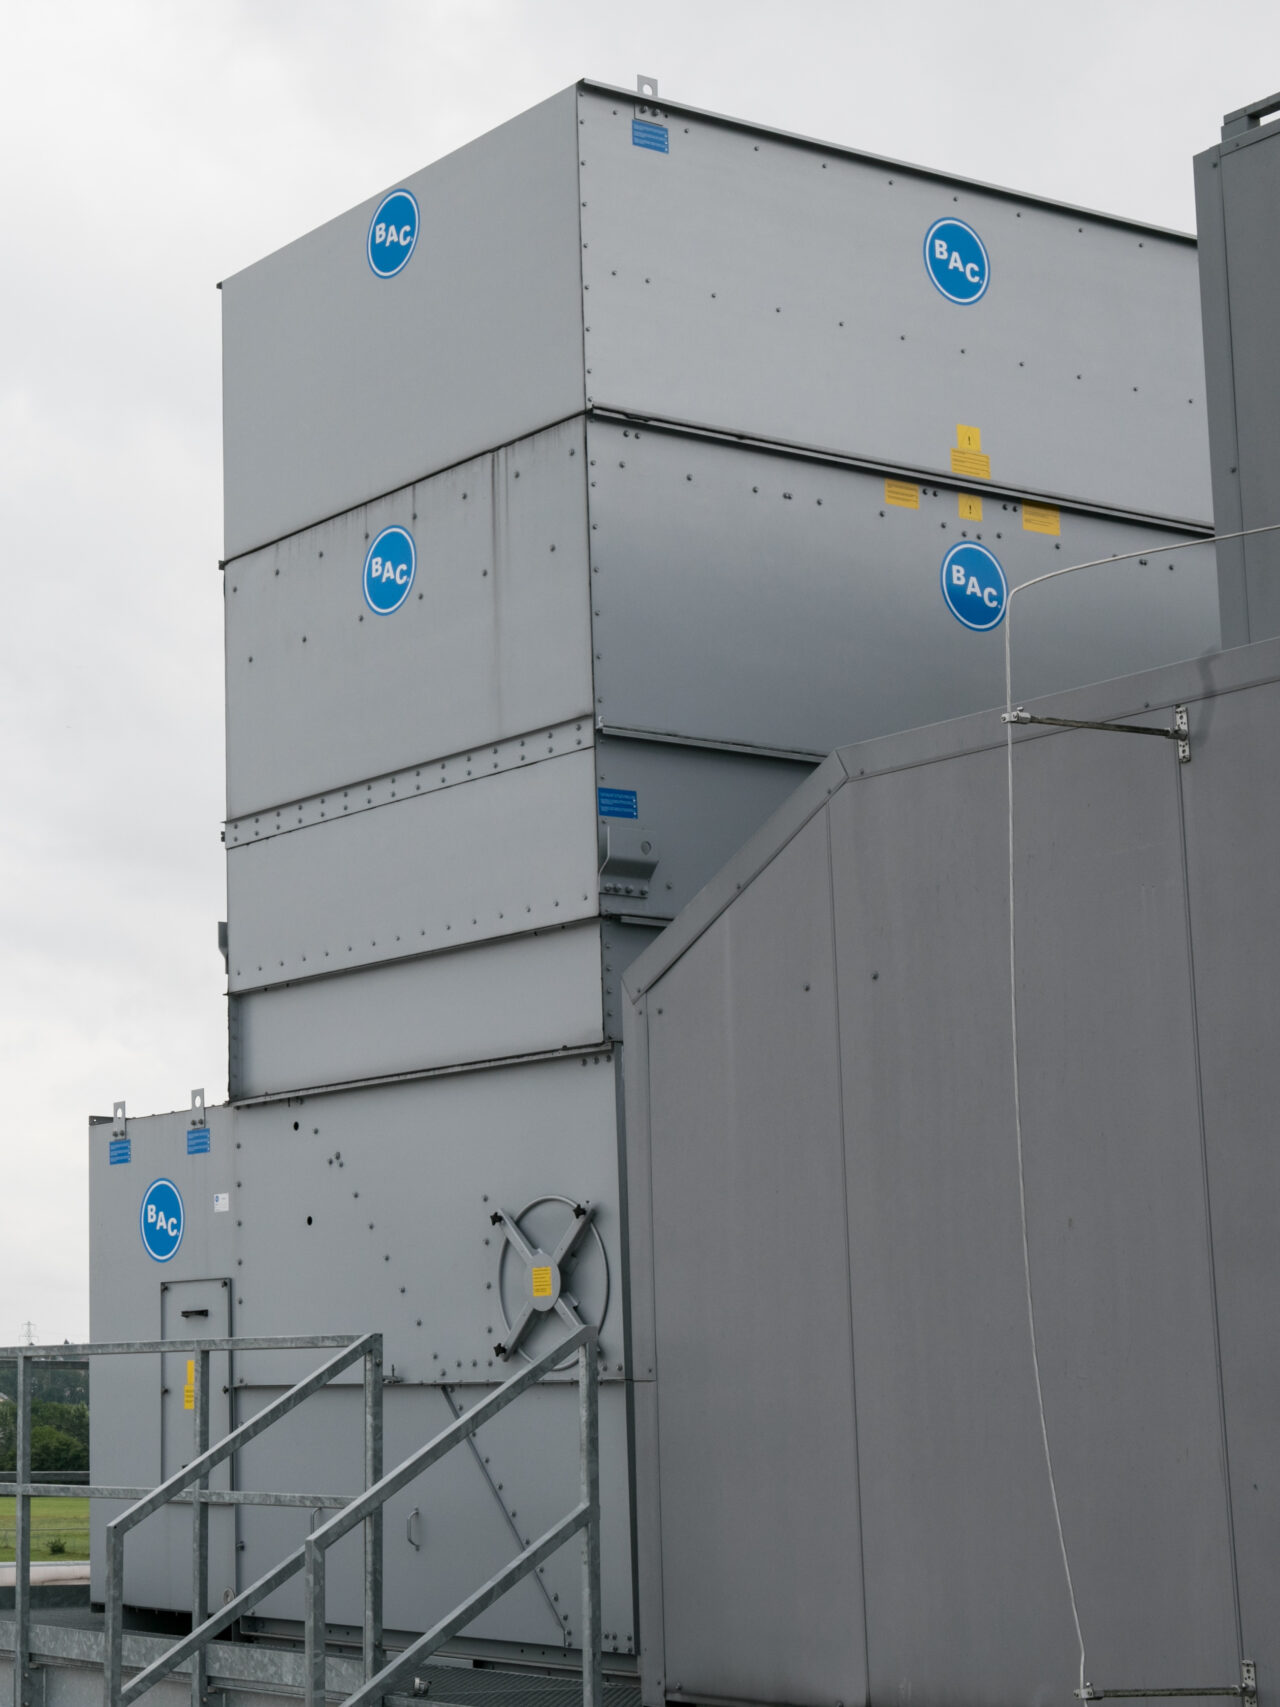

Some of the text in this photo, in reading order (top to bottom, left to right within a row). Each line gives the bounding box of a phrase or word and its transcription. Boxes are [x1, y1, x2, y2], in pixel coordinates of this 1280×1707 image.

[375, 222, 411, 246] BAC
[934, 239, 979, 282] BAC
[371, 557, 407, 584] BAC
[952, 564, 997, 607] BAC
[147, 1204, 177, 1236] BAC
